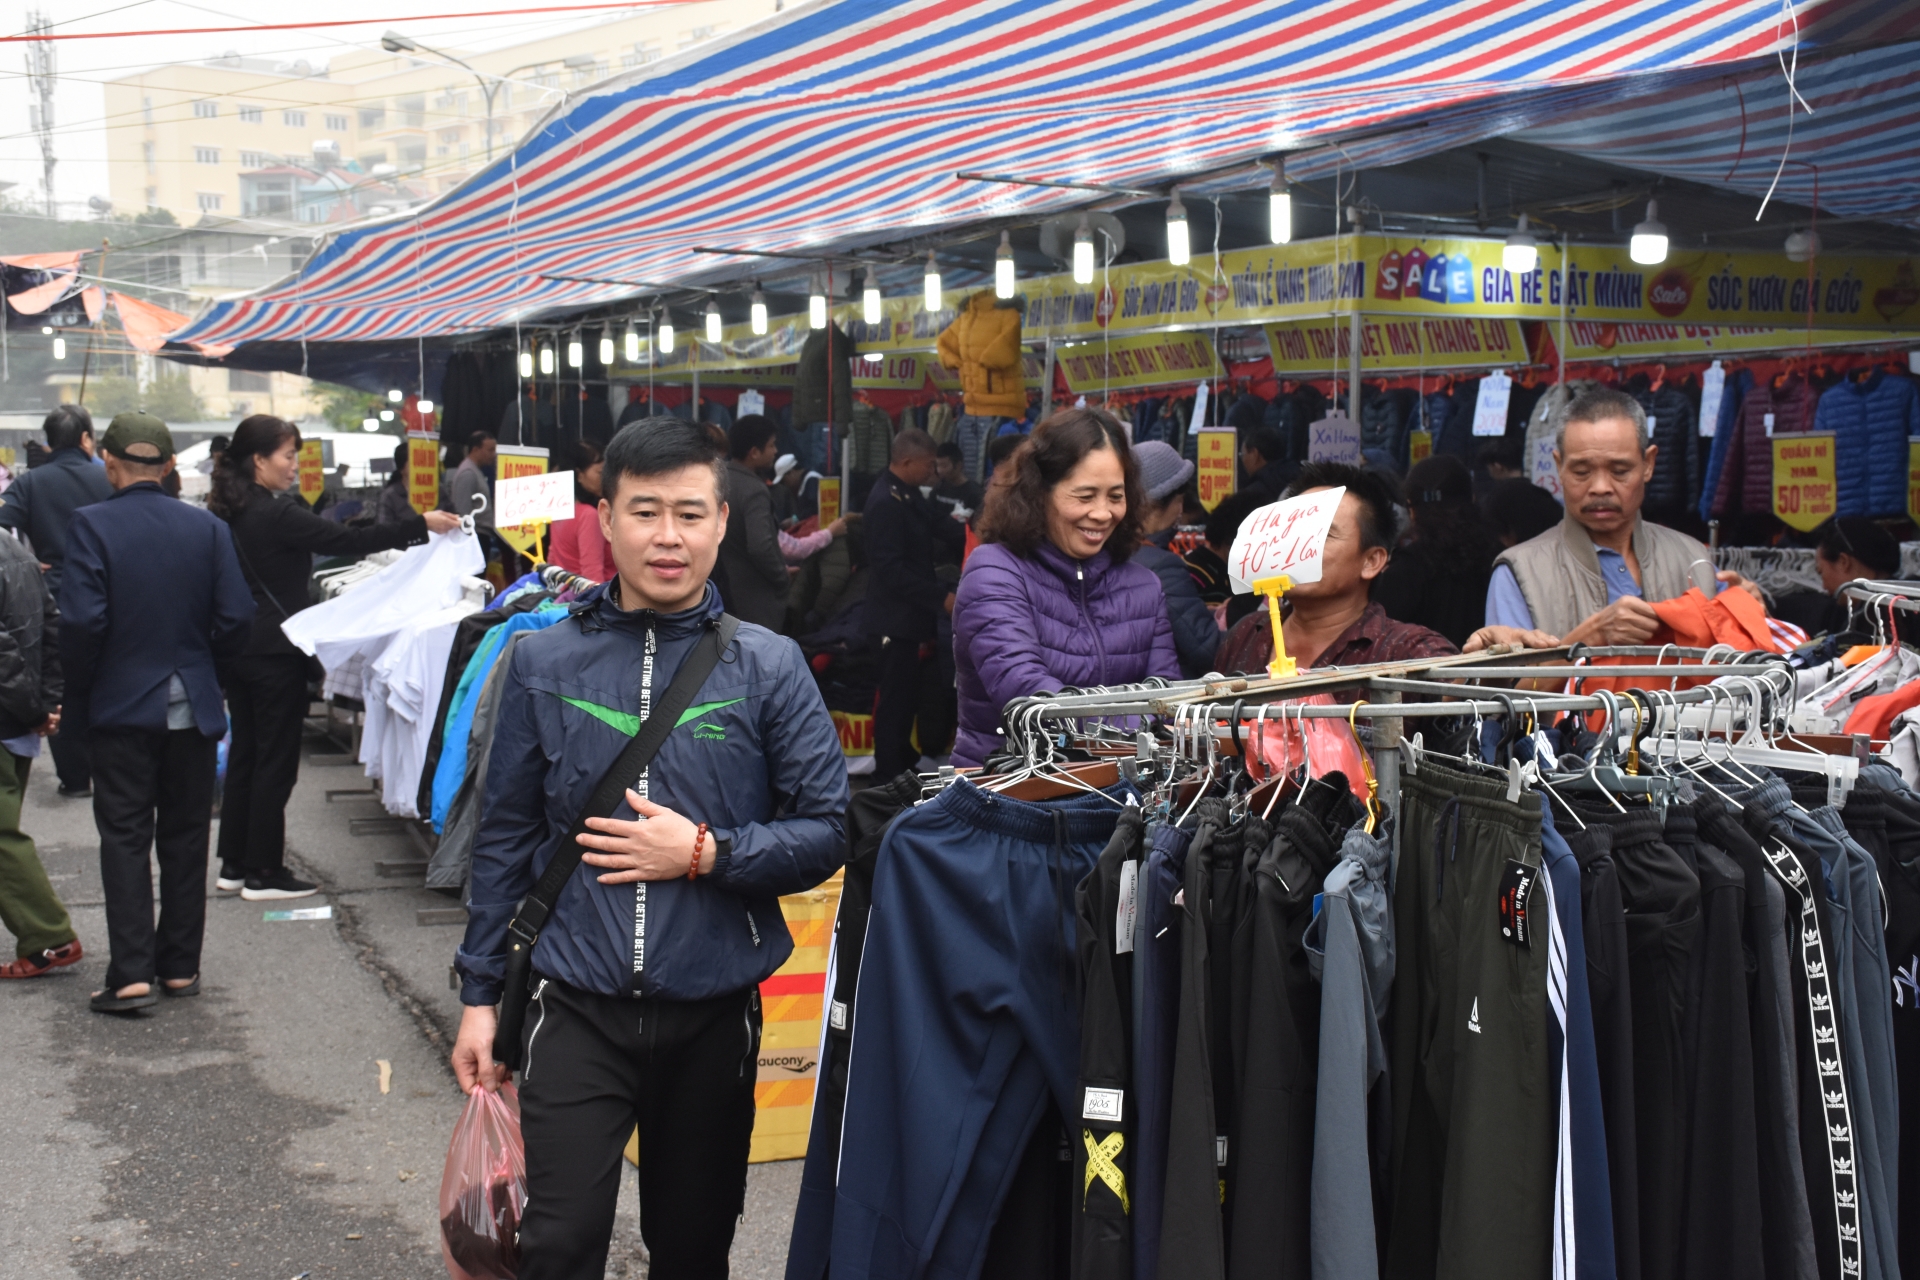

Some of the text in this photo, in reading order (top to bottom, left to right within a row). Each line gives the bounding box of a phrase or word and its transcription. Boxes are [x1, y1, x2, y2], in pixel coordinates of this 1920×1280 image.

[1382, 267, 1468, 295] SALE
[1595, 264, 1642, 309] MÌNH
[1708, 263, 1863, 314] SỐC HƠN GIÁ GỐC
[1651, 285, 1687, 305] Sale
[1385, 322, 1423, 355] MAY
[889, 358, 916, 383] LỢI
[1790, 466, 1818, 478] NAM
[1200, 475, 1213, 501] 50
[1778, 485, 1800, 514] 50
[635, 902, 646, 937] GETTING
[1515, 876, 1530, 942] Made in Vietnam
[1125, 905, 1135, 940] Vietnam
[1809, 971, 1825, 980] adidas
[1813, 1004, 1830, 1012] adidas
[1816, 1036, 1835, 1045] adidas
[757, 1056, 804, 1067] aucony
[1831, 1135, 1850, 1143] adidas
[1834, 1168, 1853, 1176] adidas
[1837, 1201, 1856, 1209] adidas
